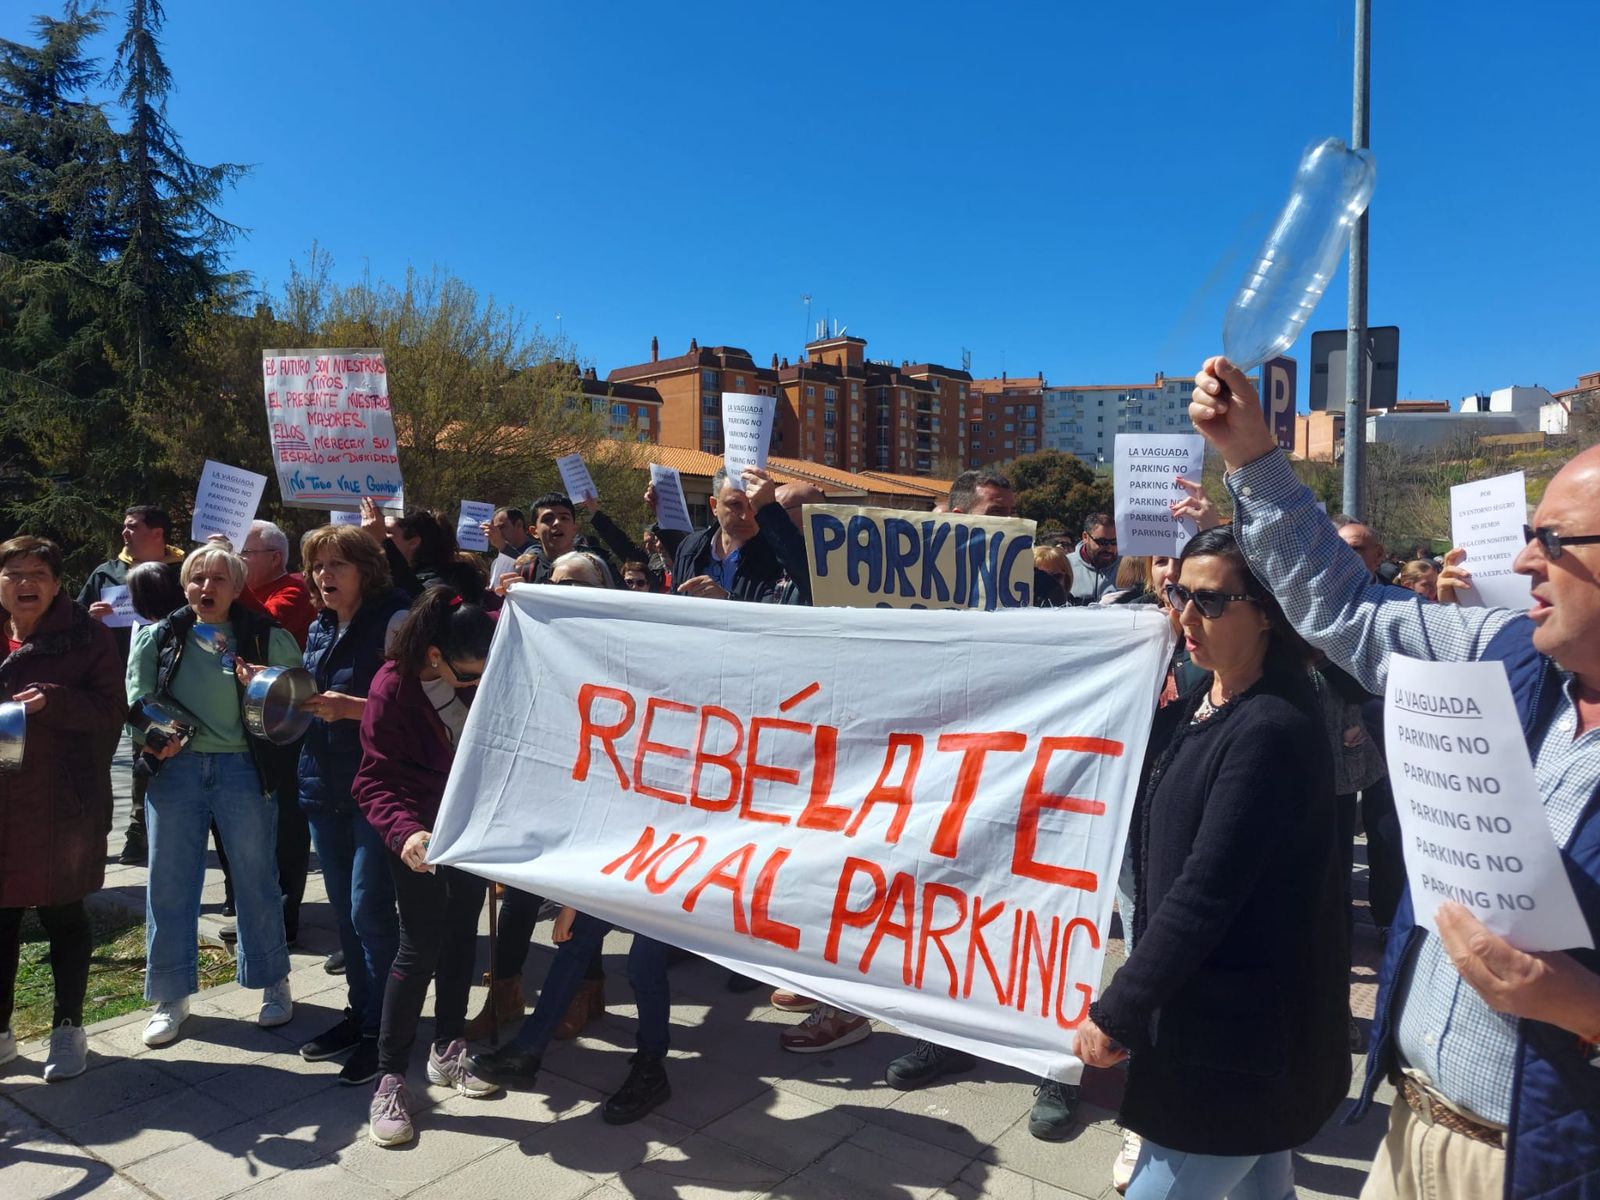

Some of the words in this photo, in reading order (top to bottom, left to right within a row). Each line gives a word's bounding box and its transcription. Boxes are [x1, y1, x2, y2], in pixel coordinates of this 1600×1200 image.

[280, 359, 310, 376] FUTURO
[315, 357, 330, 373] SON
[333, 357, 386, 374] NUESTROS
[268, 392, 282, 408] EL
[286, 392, 338, 409] PRESENTE
[1271, 366, 1290, 436] P
[734, 405, 764, 413] VAGUADA
[273, 423, 306, 441] ELLOS
[314, 436, 365, 450] MERECEN
[372, 437, 389, 449] SU
[749, 432, 760, 440] NO
[280, 451, 324, 464] ESPACIO
[344, 452, 398, 464] DIGNIDAD
[1128, 448, 1139, 456] LA
[1141, 448, 1189, 457] VAGUADA
[1130, 464, 1170, 473] PARKING
[1172, 465, 1188, 474] NO
[212, 471, 220, 480] LA
[222, 473, 255, 488] VAGUADA
[305, 476, 332, 490] TODO
[337, 475, 361, 493] VALE
[1129, 481, 1169, 490] PARKING
[211, 482, 240, 495] PARKING
[241, 490, 252, 498] NO
[208, 492, 237, 505] PARKING
[238, 500, 249, 508] NO
[1129, 497, 1168, 507] PARKING
[205, 502, 233, 515] PARKING
[234, 510, 245, 518] NO
[1467, 506, 1492, 516] ENTORNO
[1493, 501, 1516, 511] SEGURO
[202, 513, 230, 525] PARKING
[231, 520, 241, 528] NO
[1129, 513, 1168, 523] PARKING
[1171, 515, 1184, 524] NO
[1131, 528, 1171, 538] PARKING
[1172, 531, 1186, 540] NO
[1486, 535, 1518, 545] NOSOTROS
[811, 514, 1033, 612] PARKING
[1487, 552, 1512, 561] MARTES
[1487, 569, 1512, 577] EXPLAN
[1395, 687, 1404, 705] LA
[1404, 690, 1481, 715] VAGUADA
[1398, 725, 1453, 752] PARKING
[1457, 737, 1490, 755] NO
[1404, 762, 1461, 791] PARKING
[1466, 776, 1501, 794] NO
[572, 681, 1124, 893] REBÉLATE
[1410, 799, 1470, 831] PARKING
[1476, 815, 1512, 834] NO
[1416, 837, 1480, 870] PARKING
[1487, 855, 1524, 873] NO
[1421, 873, 1490, 909] PARKING
[1496, 893, 1536, 911] NO
[600, 825, 706, 895] NO
[681, 842, 801, 951] AL
[824, 856, 1101, 1029] PARKING
